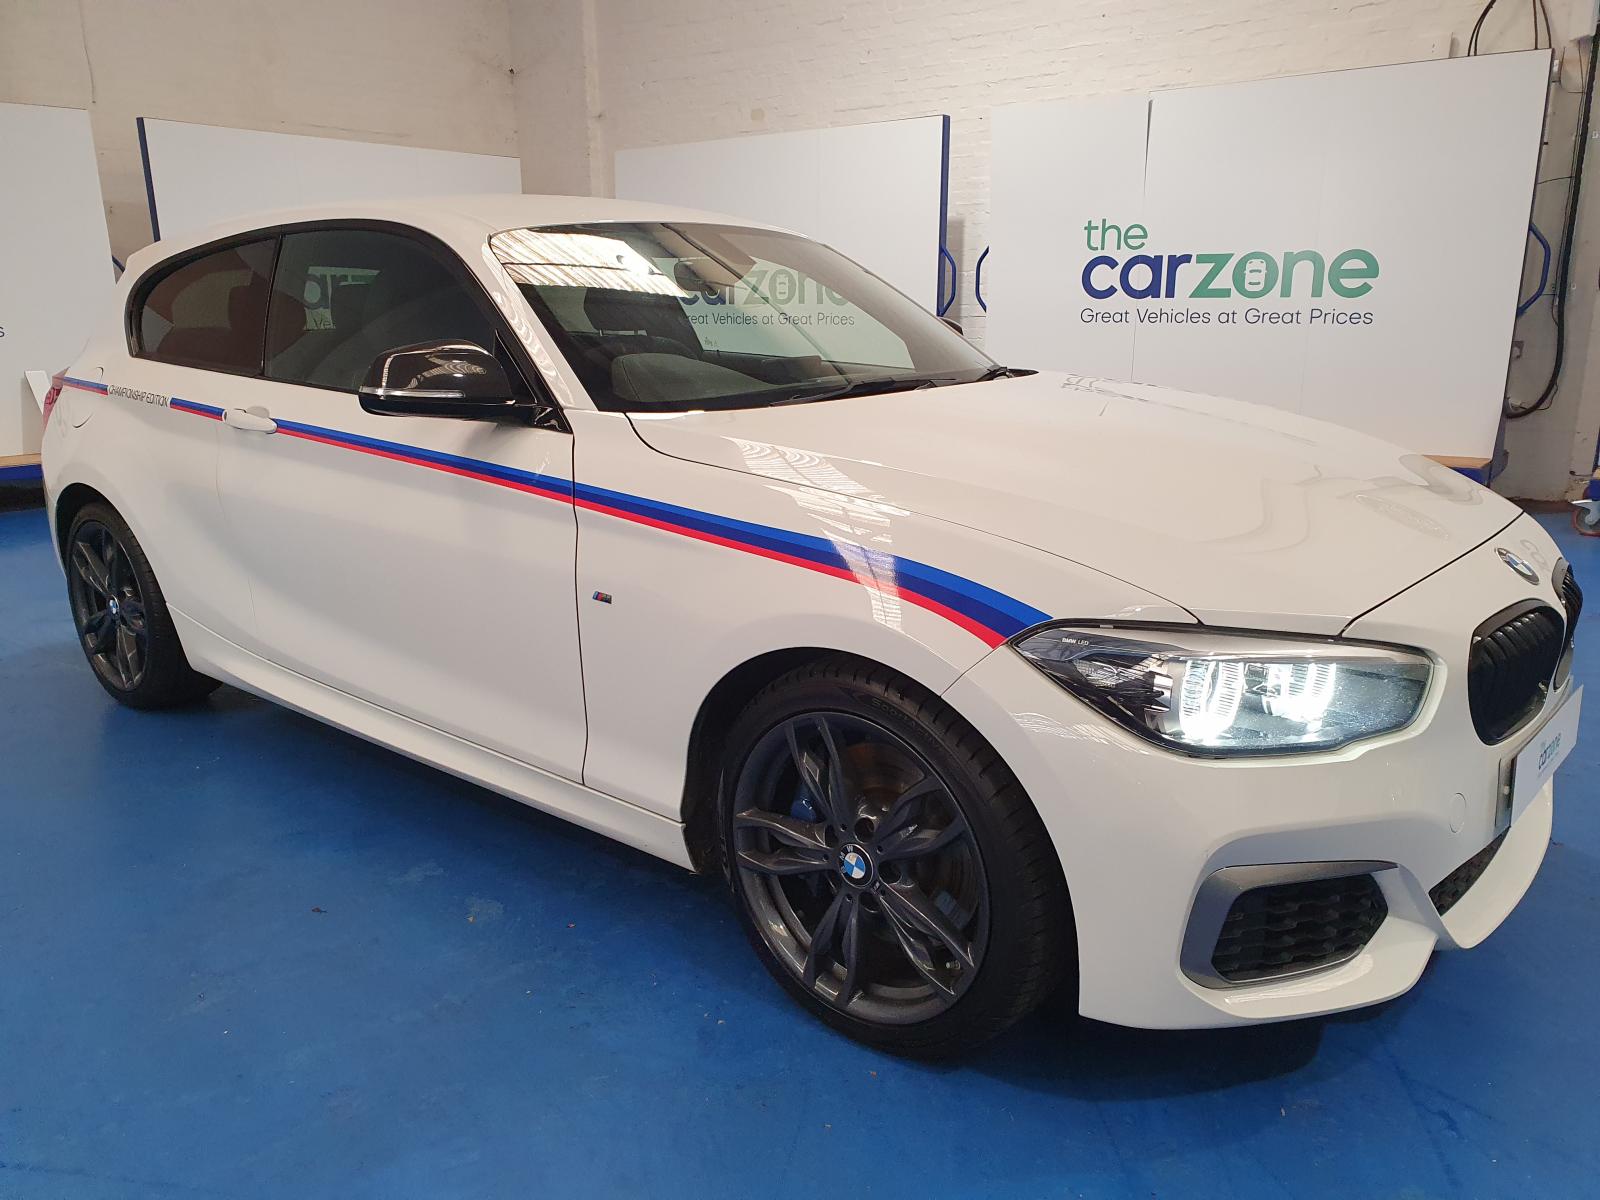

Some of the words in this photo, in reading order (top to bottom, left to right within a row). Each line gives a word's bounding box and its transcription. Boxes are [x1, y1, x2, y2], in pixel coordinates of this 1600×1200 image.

[1083, 218, 1148, 251] the
[1081, 248, 1380, 299] carzone
[712, 312, 758, 326] Vehicles
[761, 314, 774, 325] at
[778, 312, 812, 326] Great
[817, 312, 855, 326] Prices
[1080, 308, 1130, 324] Great
[1136, 307, 1211, 324] Vehicles
[1217, 310, 1237, 325] at
[1244, 308, 1302, 326] Great
[1309, 308, 1374, 326] Prices
[146, 392, 168, 407] EDITION
